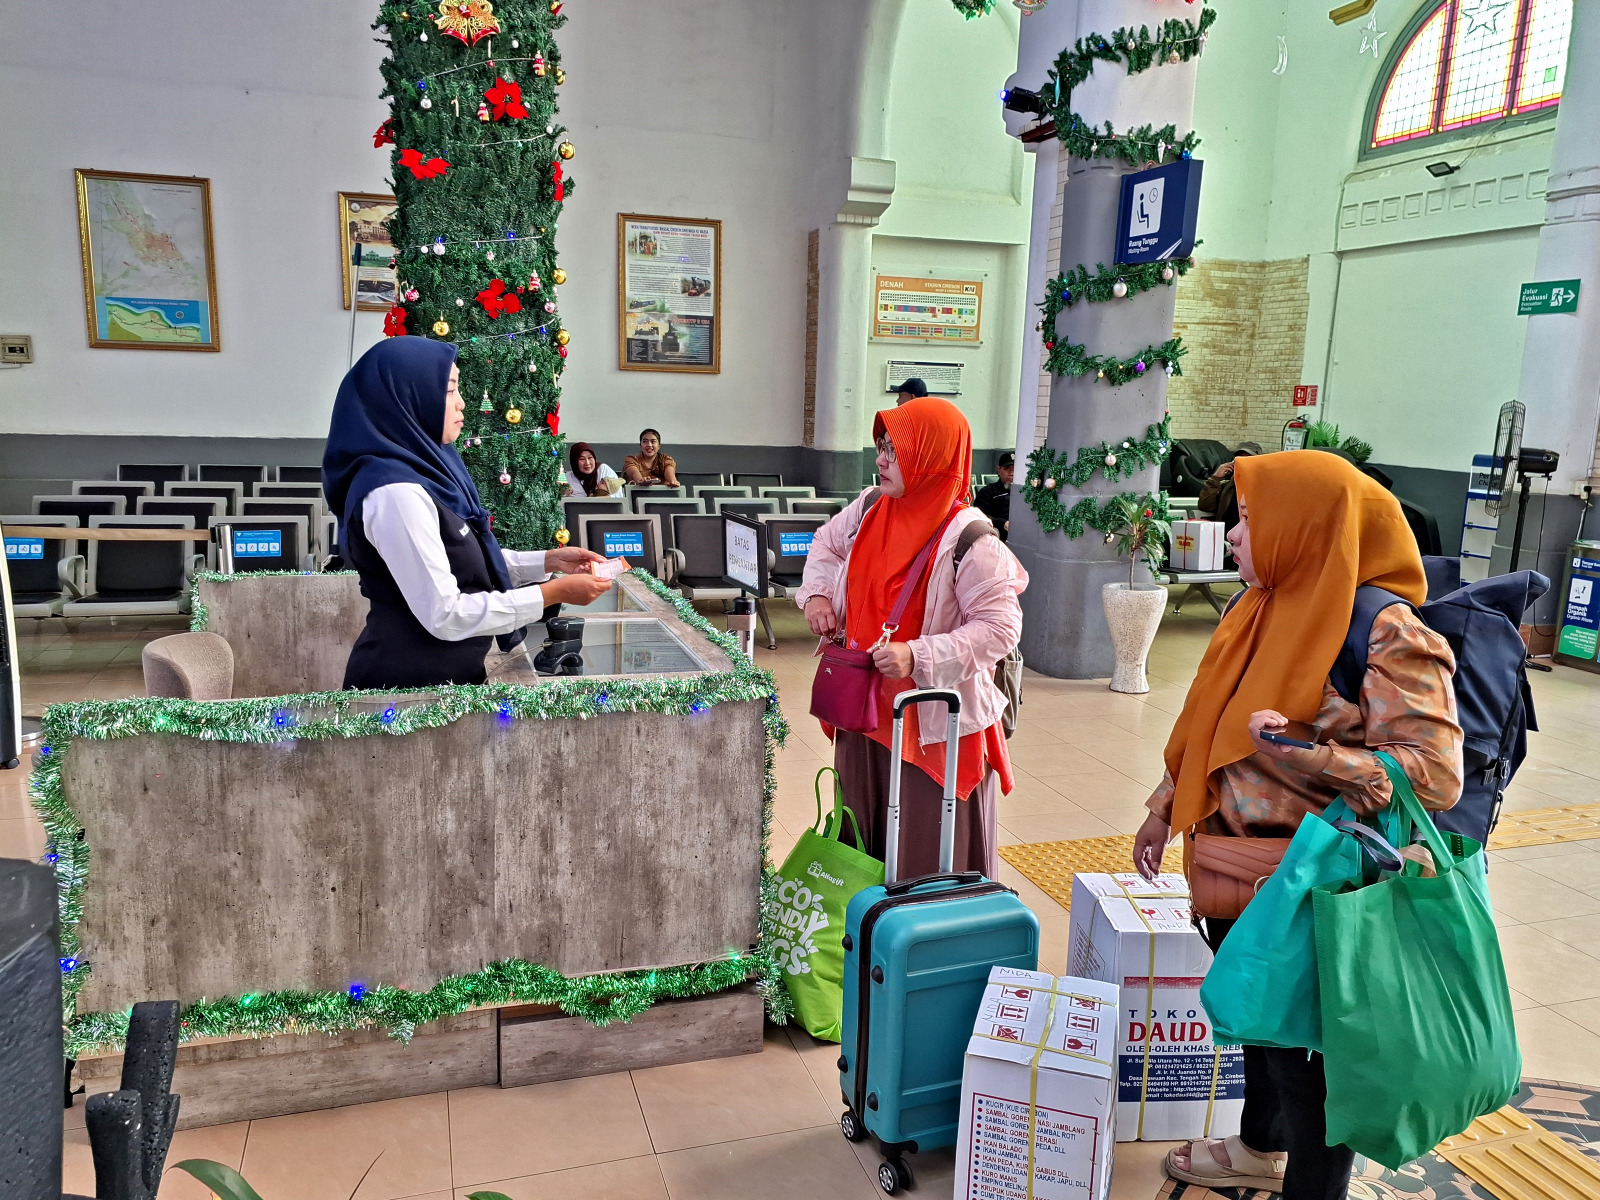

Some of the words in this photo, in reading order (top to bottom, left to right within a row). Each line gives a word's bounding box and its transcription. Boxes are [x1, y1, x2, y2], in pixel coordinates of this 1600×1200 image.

[1128, 240, 1142, 248] Ruang
[1142, 237, 1158, 246] Tunggu
[880, 280, 904, 288] DENAH
[734, 535, 750, 551] BATAS
[1568, 603, 1587, 612] Sampah
[1568, 609, 1587, 617] Organik
[820, 872, 844, 886] Alfagift
[768, 900, 829, 945] ENDLY
[778, 926, 795, 940] THE
[1000, 968, 1031, 979] NIDA
[1128, 1009, 1197, 1019] TOKO
[1127, 1022, 1207, 1042] DAUD
[986, 1100, 1004, 1109] KUCIR
[1005, 1104, 1019, 1112] (KUE
[1021, 1107, 1048, 1120] CIRBON)
[985, 1108, 1009, 1118] SAMBAL
[1037, 1119, 1051, 1127] NASI
[1052, 1123, 1085, 1134] JAMBLANG
[985, 1116, 1009, 1126] SAMBAL
[1010, 1121, 1029, 1130] GOREN
[1036, 1127, 1060, 1137] JAMBAL
[1062, 1132, 1076, 1140] ROTI
[984, 1124, 1008, 1134] SAMBAL
[1010, 1130, 1029, 1138] GOREN
[1036, 1135, 1057, 1144] TERASI
[984, 1132, 1008, 1142] SAMBAL
[1009, 1137, 1029, 1146] GOREN
[1036, 1143, 1053, 1152] PEDA,
[1055, 1146, 1066, 1154] DLL
[999, 1143, 1022, 1153] BALADO
[983, 1147, 997, 1155] IKAN
[998, 1150, 1021, 1160] JAMBAL
[983, 1155, 996, 1163] IKAN
[998, 1158, 1014, 1168] PEDA,
[1036, 1167, 1056, 1175] GABUS
[982, 1161, 1010, 1172] DENDENG
[1011, 1169, 1027, 1177] UDAN
[1035, 1173, 1056, 1183] KAKAP,
[1057, 1178, 1074, 1187] JAPU,
[982, 1169, 998, 1178] KURO
[999, 1174, 1017, 1183] MANIS
[981, 1176, 1003, 1187] EMPING
[980, 1191, 994, 1199] CUMI
[981, 1184, 1005, 1195] KRUPUK
[1005, 1190, 1026, 1199] UDANG
